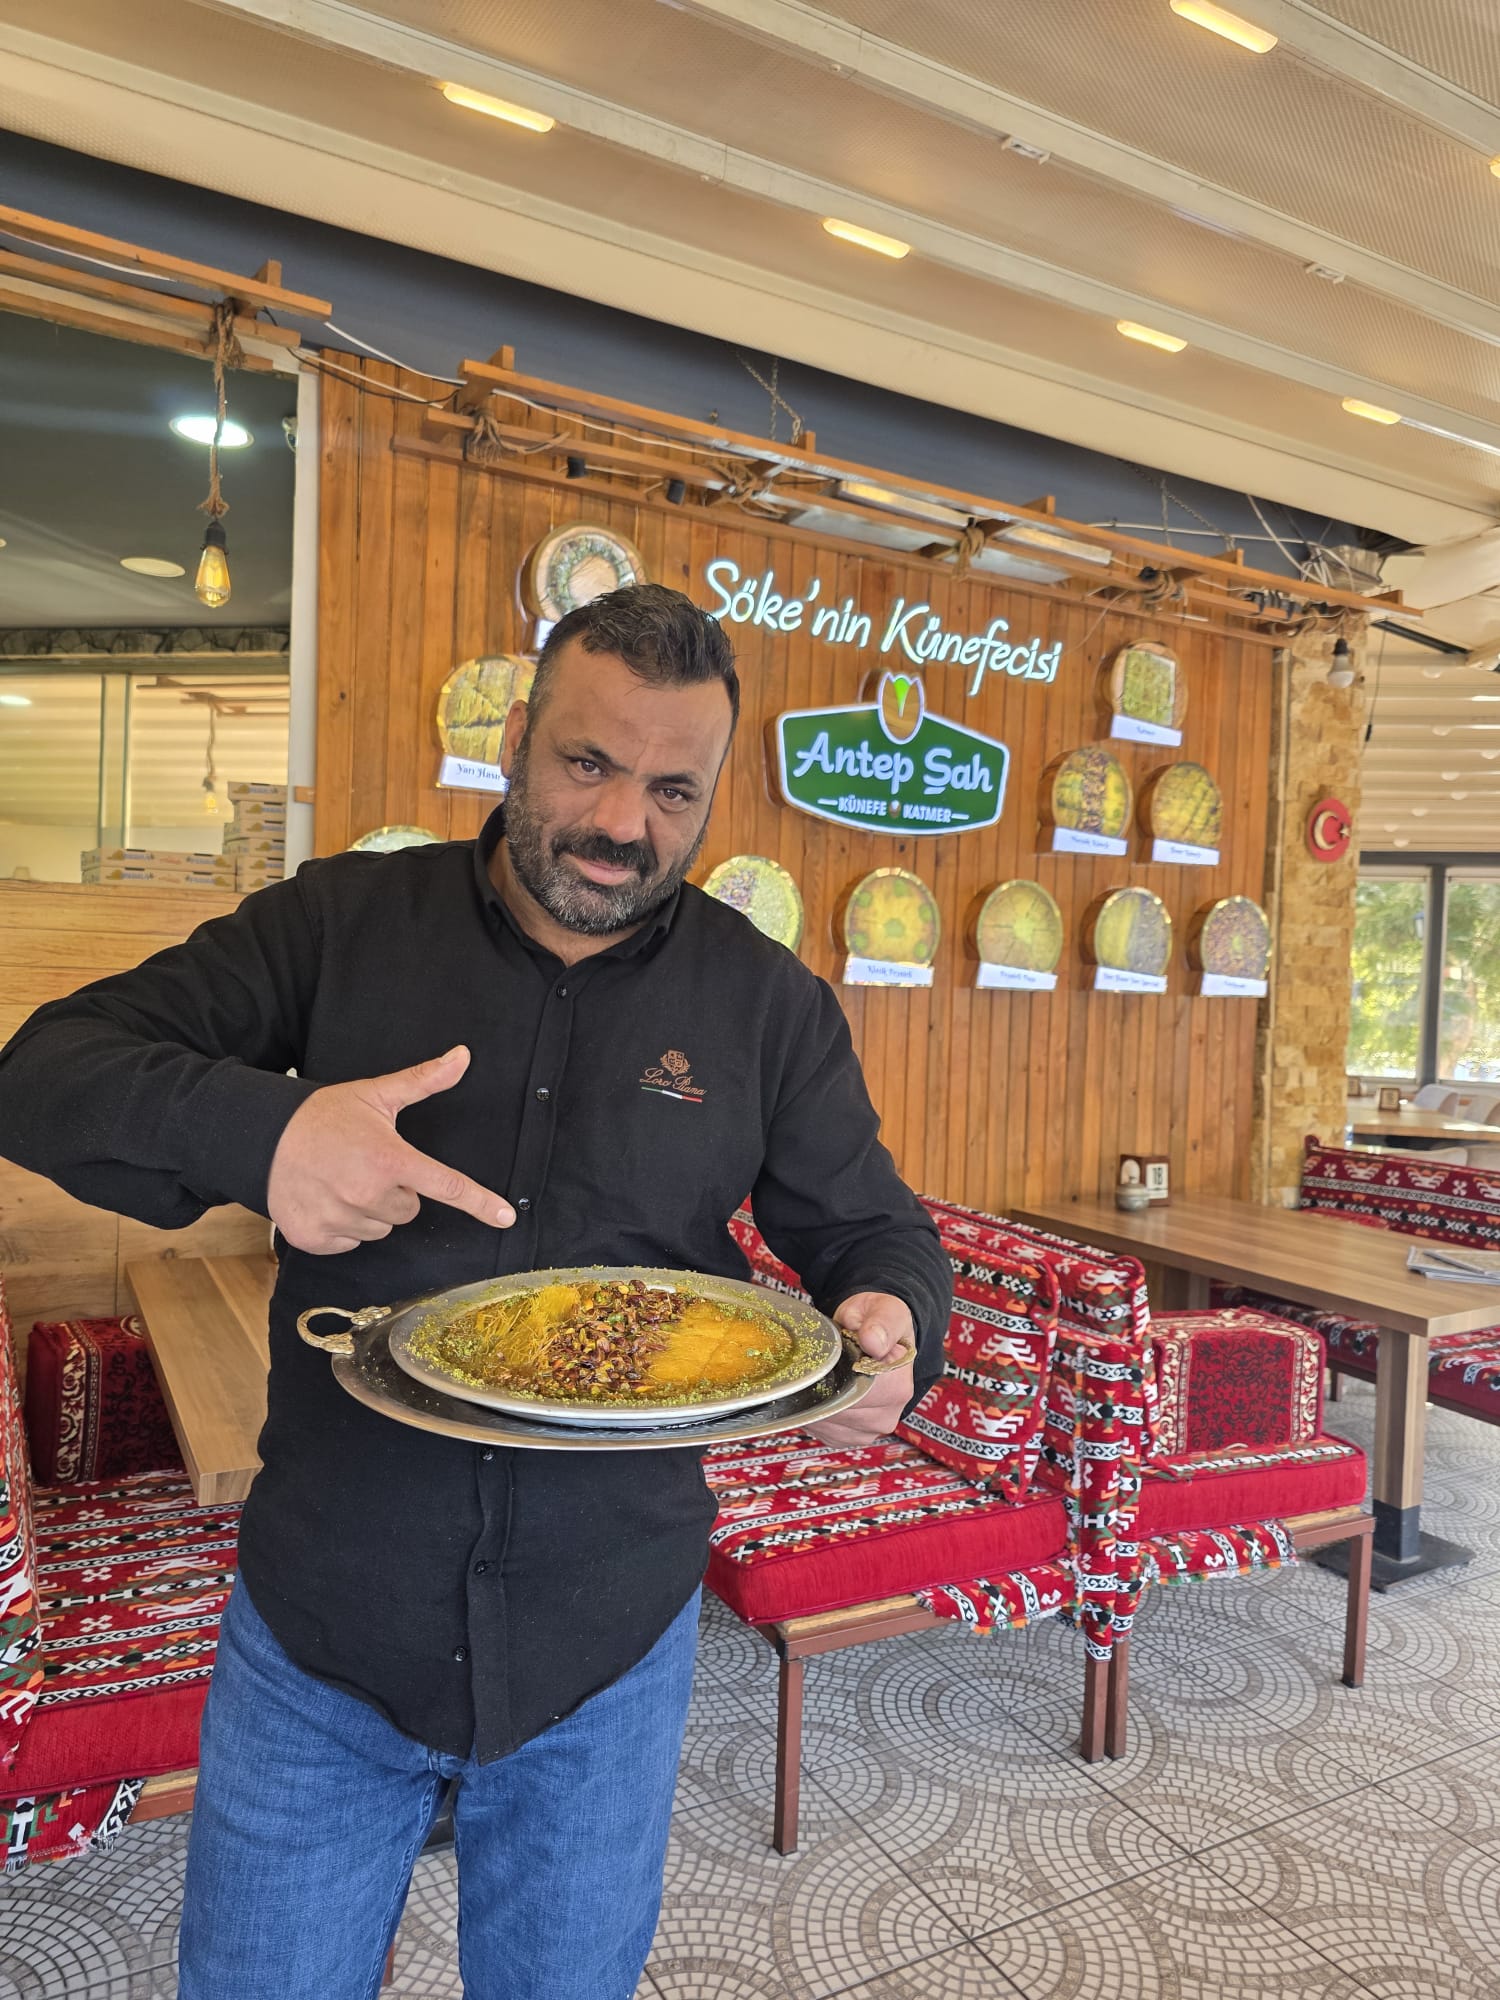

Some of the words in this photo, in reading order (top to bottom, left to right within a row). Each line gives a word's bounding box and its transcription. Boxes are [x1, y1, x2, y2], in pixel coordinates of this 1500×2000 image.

[706, 560, 871, 648] Söke'nin
[880, 598, 1063, 696] Künefecisi
[793, 732, 914, 795] Antep
[922, 748, 993, 795] Şah
[837, 794, 887, 816] KÜNEFE
[902, 803, 952, 823] KATMER
